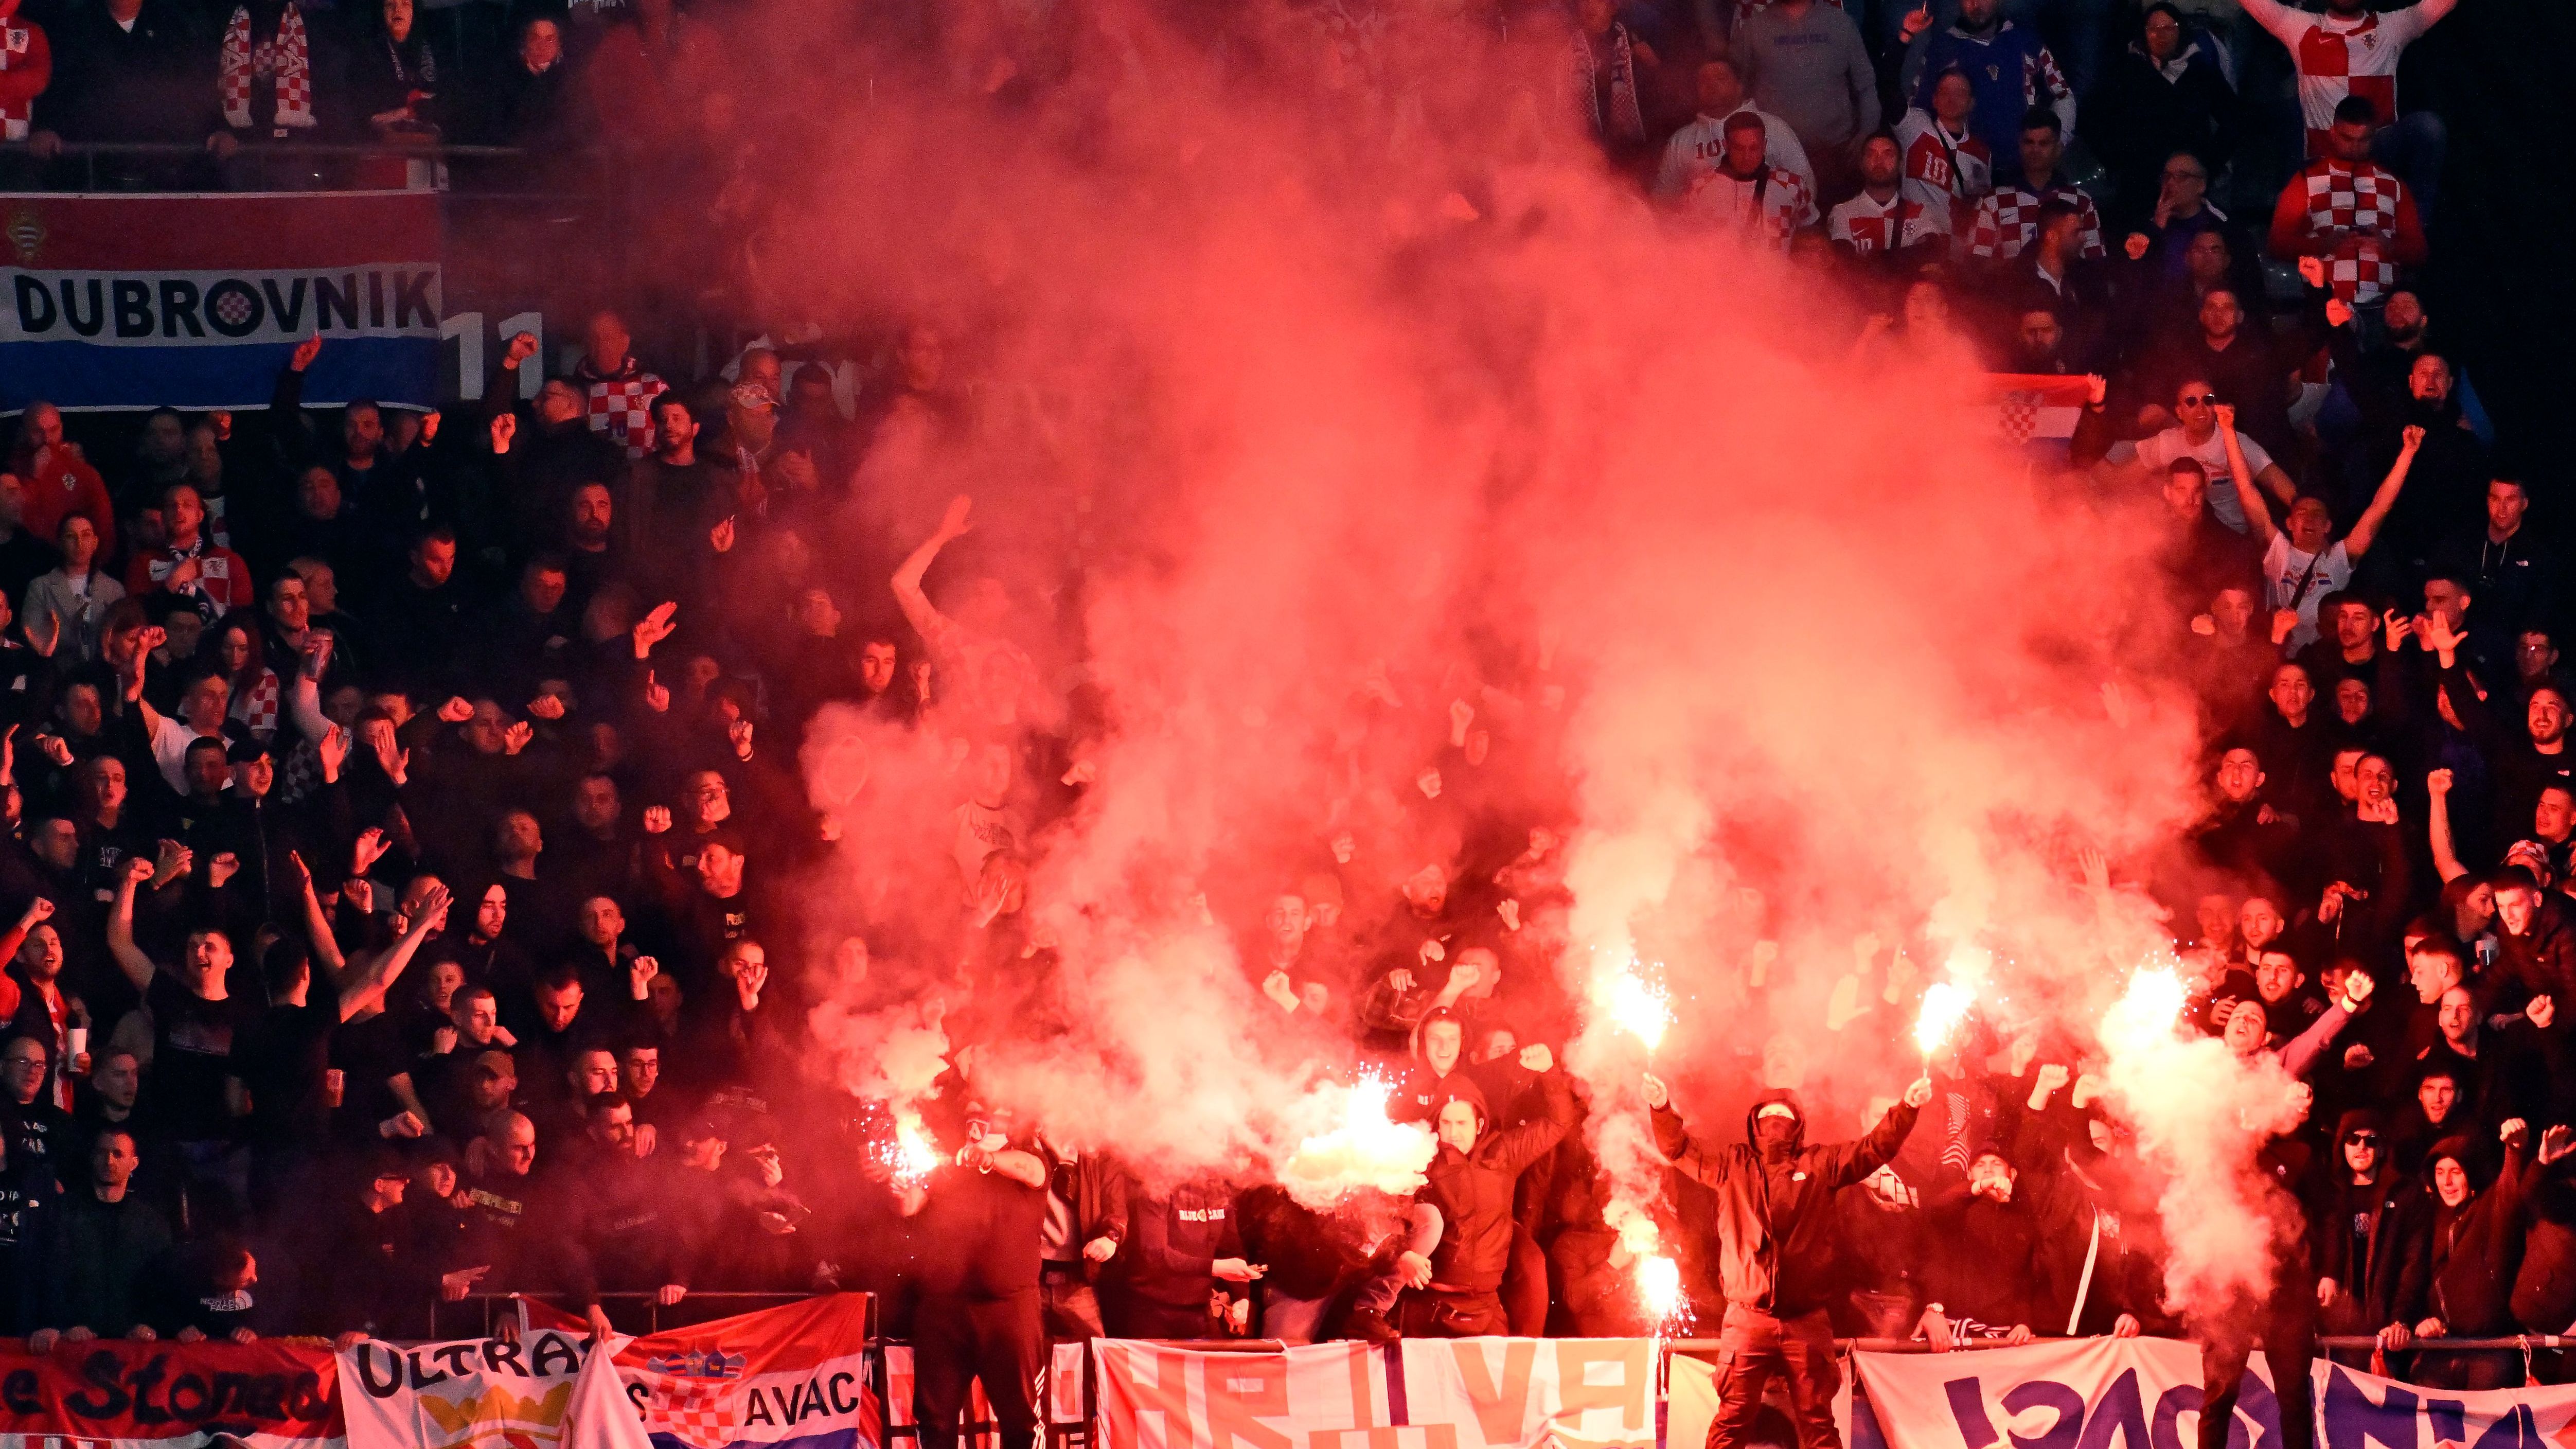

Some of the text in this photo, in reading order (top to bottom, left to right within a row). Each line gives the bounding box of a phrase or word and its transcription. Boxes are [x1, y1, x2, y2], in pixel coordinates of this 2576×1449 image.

[14, 270, 438, 338] DUBROVNIK
[441, 311, 543, 400] 11
[357, 1332, 591, 1399] ULTRA
[744, 1372, 859, 1426] AVAC
